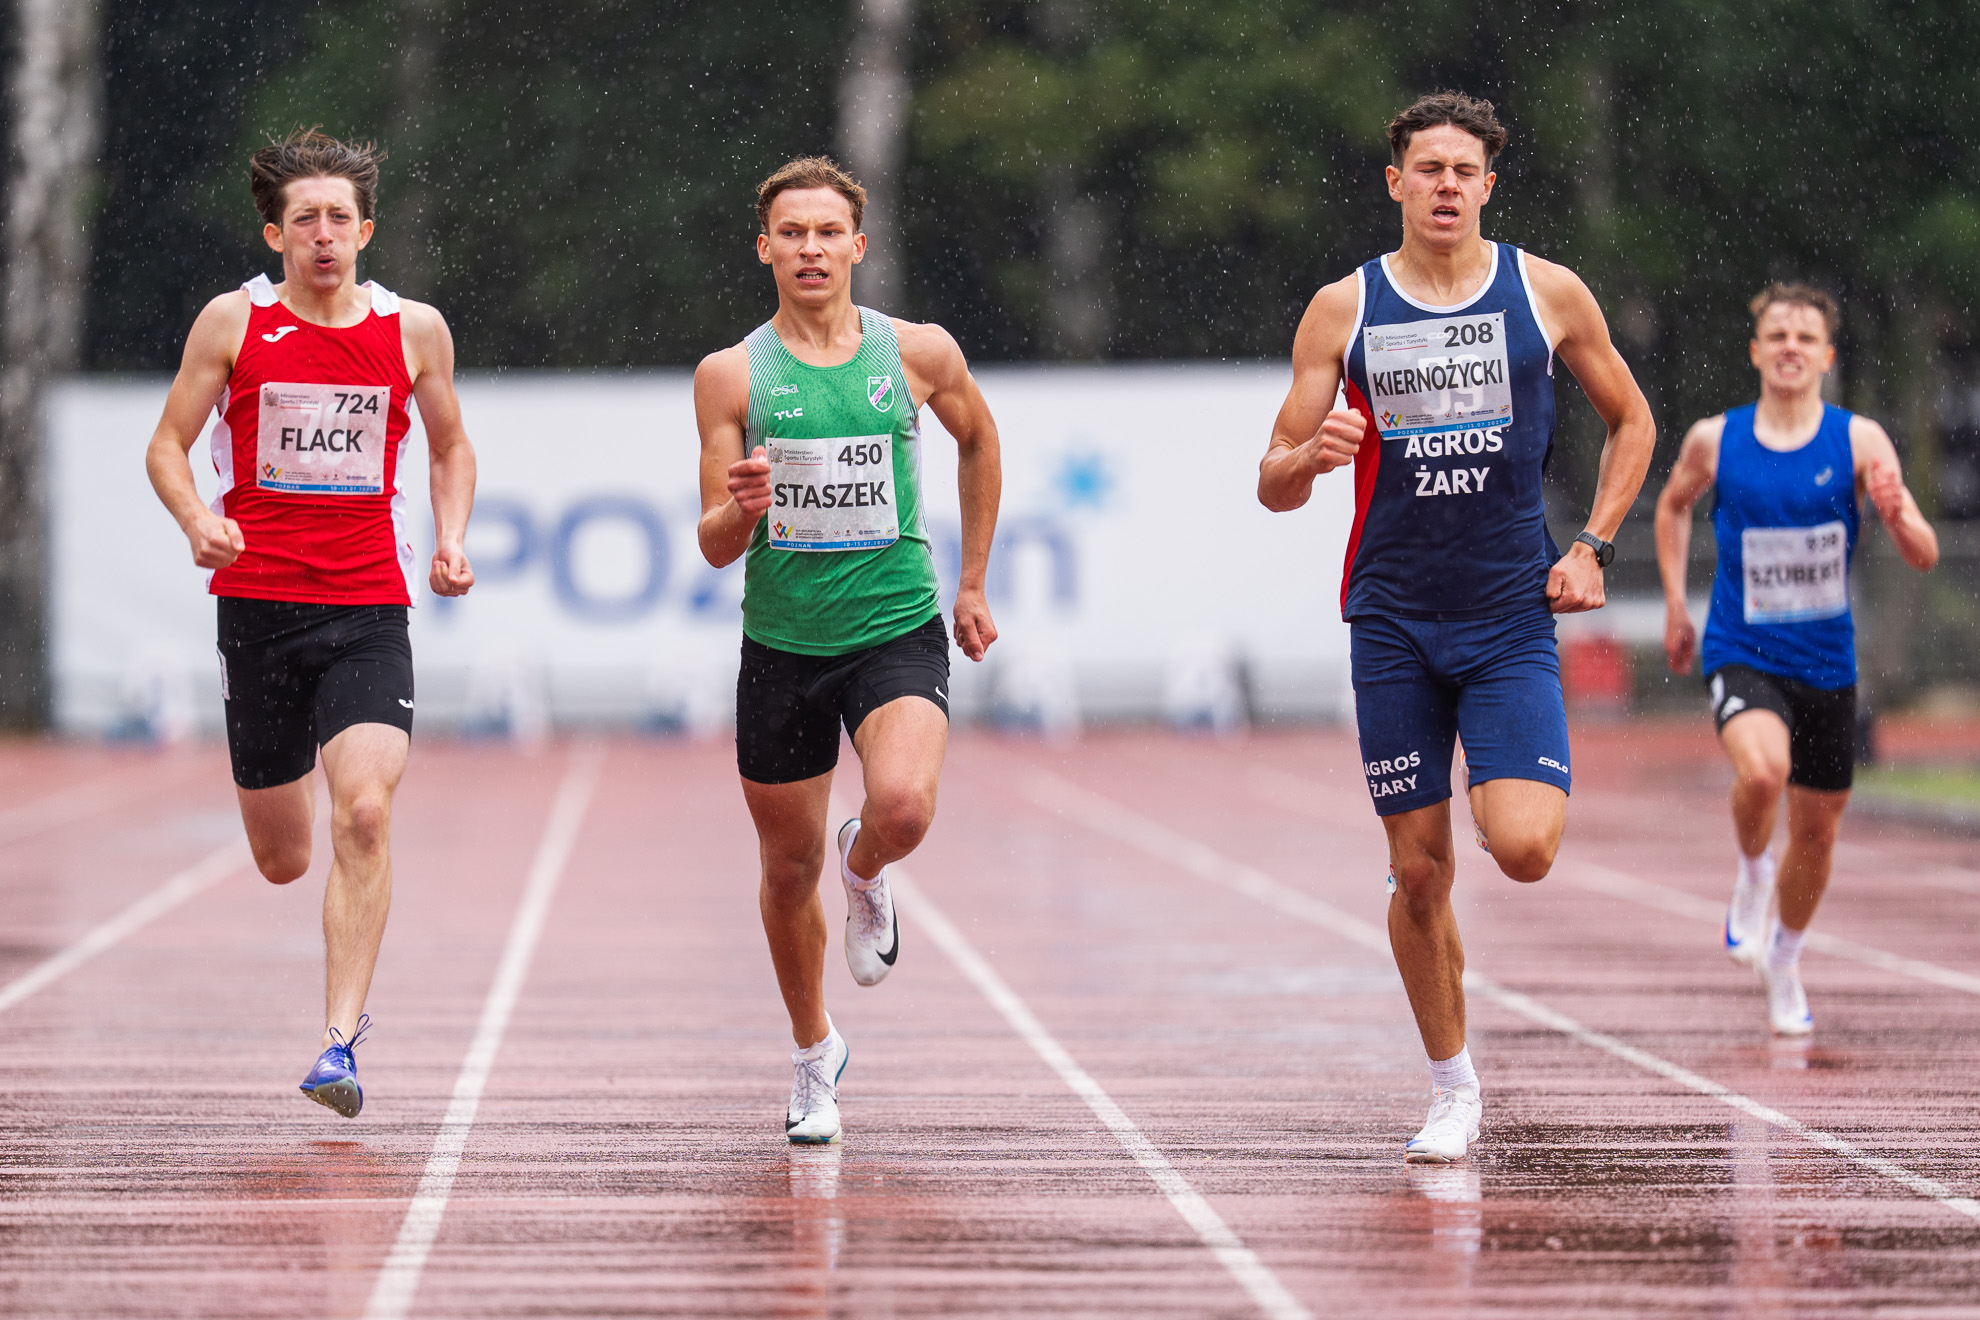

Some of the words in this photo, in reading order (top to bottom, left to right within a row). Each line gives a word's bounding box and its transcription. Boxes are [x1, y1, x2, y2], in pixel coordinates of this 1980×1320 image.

[1385, 333, 1418, 341] Ministerstwo
[1443, 322, 1494, 348] 208
[1372, 358, 1504, 397] KIERNOŻYCKI
[334, 392, 379, 415] 724
[773, 407, 804, 421] TLC
[280, 427, 364, 453] FLACK
[1404, 427, 1504, 459] AGROS
[837, 443, 883, 467] 450
[1415, 464, 1491, 497] ŻARY
[774, 481, 888, 509] STASZEK
[1537, 756, 1569, 774] COLO
[1370, 774, 1417, 798] ŻARY
